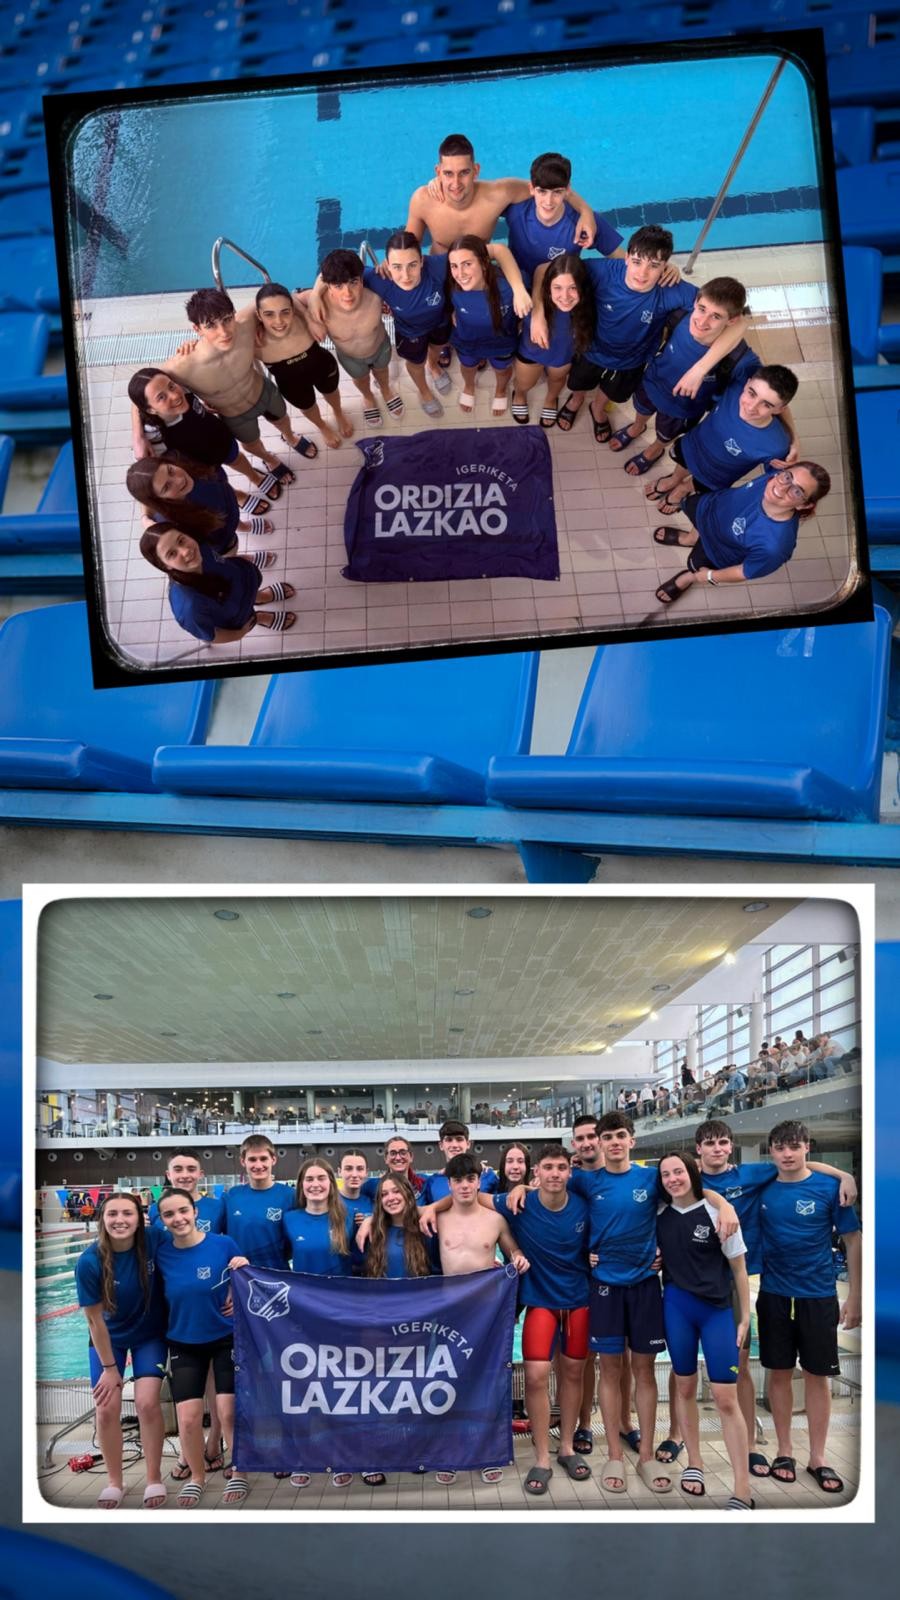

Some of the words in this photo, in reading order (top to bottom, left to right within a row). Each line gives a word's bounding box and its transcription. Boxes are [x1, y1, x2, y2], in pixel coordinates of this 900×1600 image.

[456, 464, 518, 493] IGERIKETA
[374, 482, 508, 511] ORDIZIA
[374, 507, 508, 538] LAZKAO
[391, 1321, 475, 1360] IGERIKETA
[280, 1342, 458, 1379] ORDIZIA
[281, 1380, 457, 1416] LAZKAO
